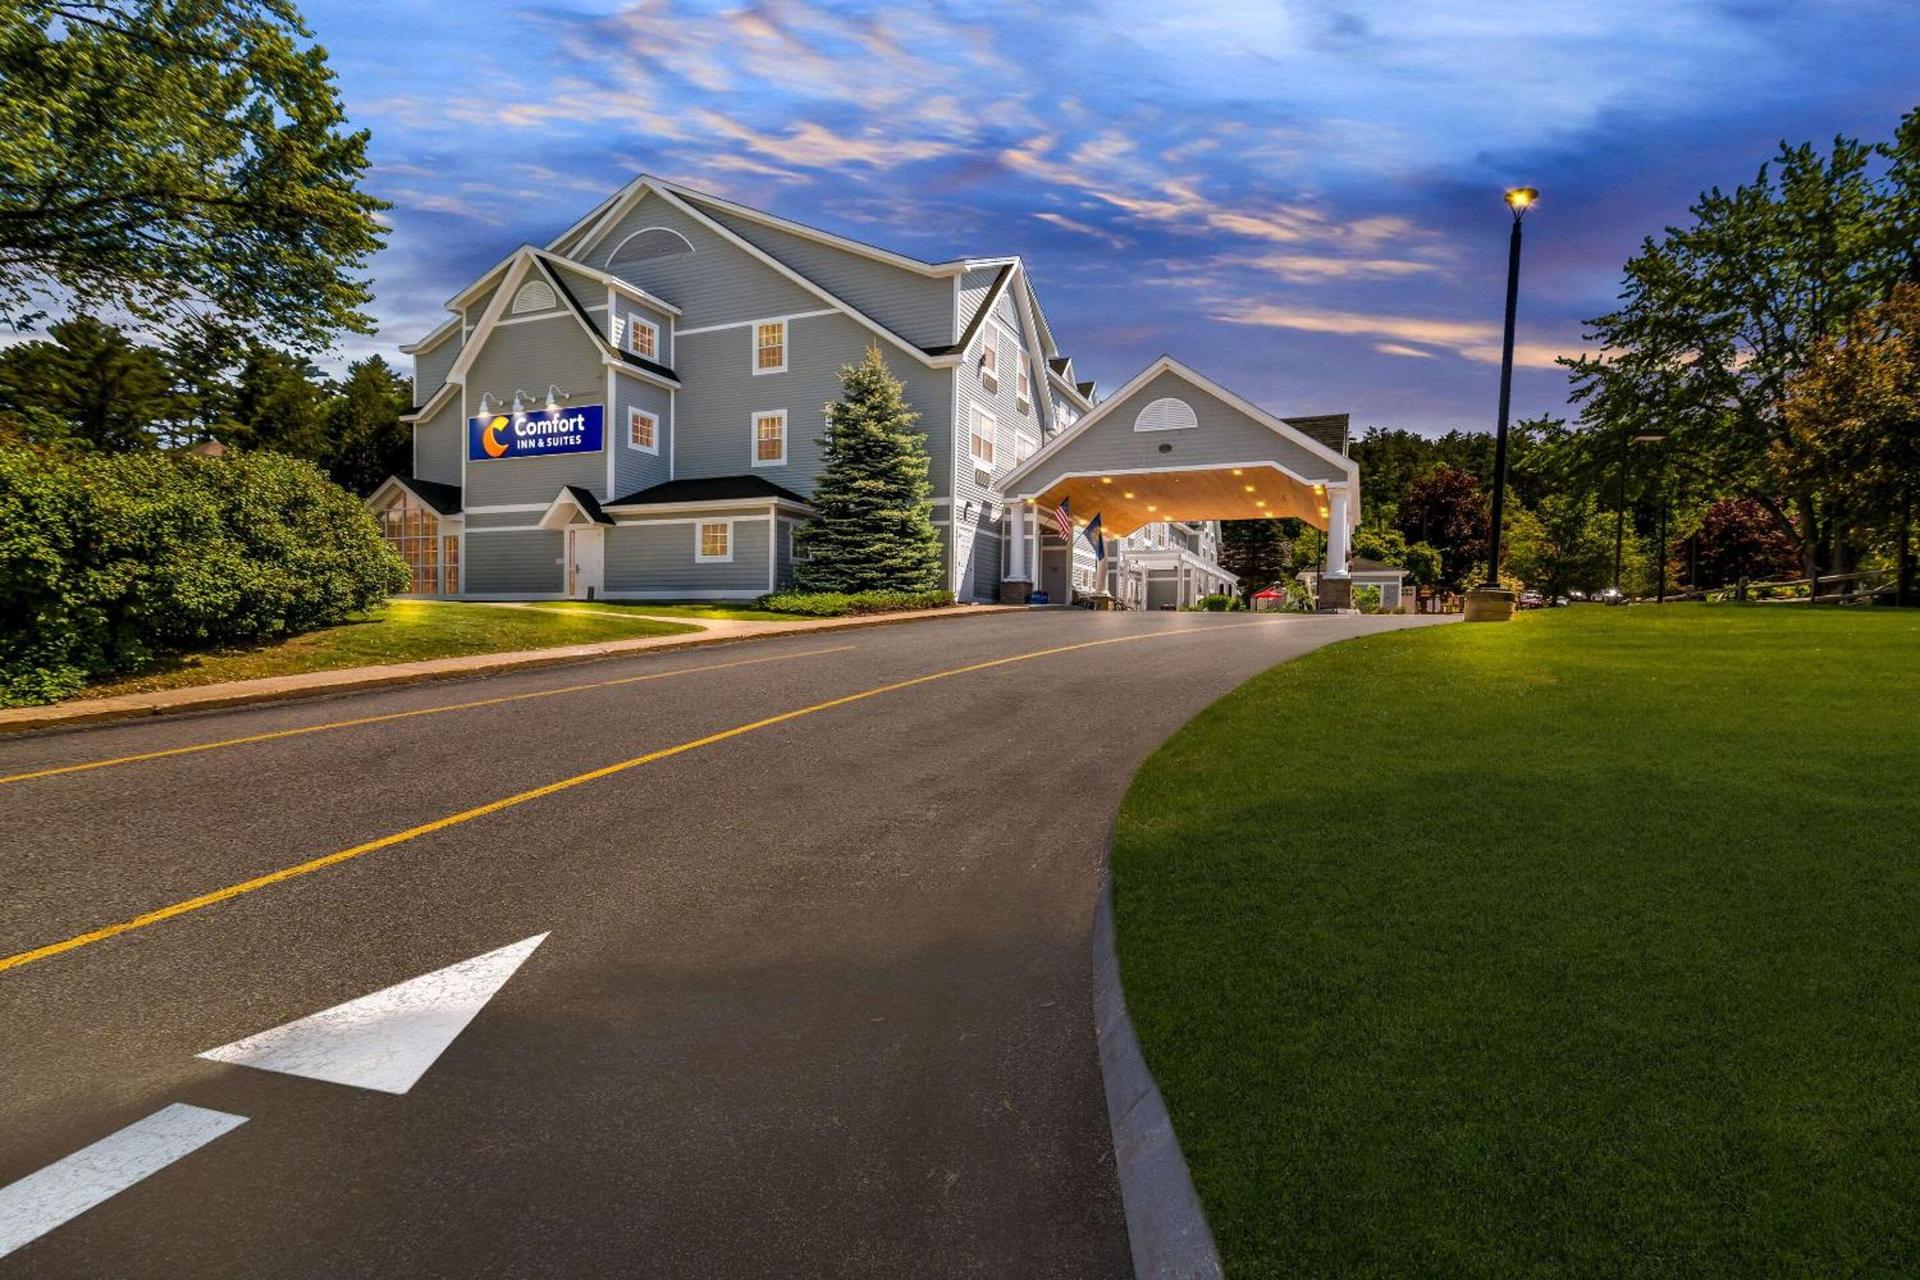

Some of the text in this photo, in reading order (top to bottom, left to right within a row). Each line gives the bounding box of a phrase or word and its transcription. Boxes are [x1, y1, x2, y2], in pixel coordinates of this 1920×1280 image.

[515, 413, 585, 436] Comfort
[517, 435, 582, 449] INN & SUITES
